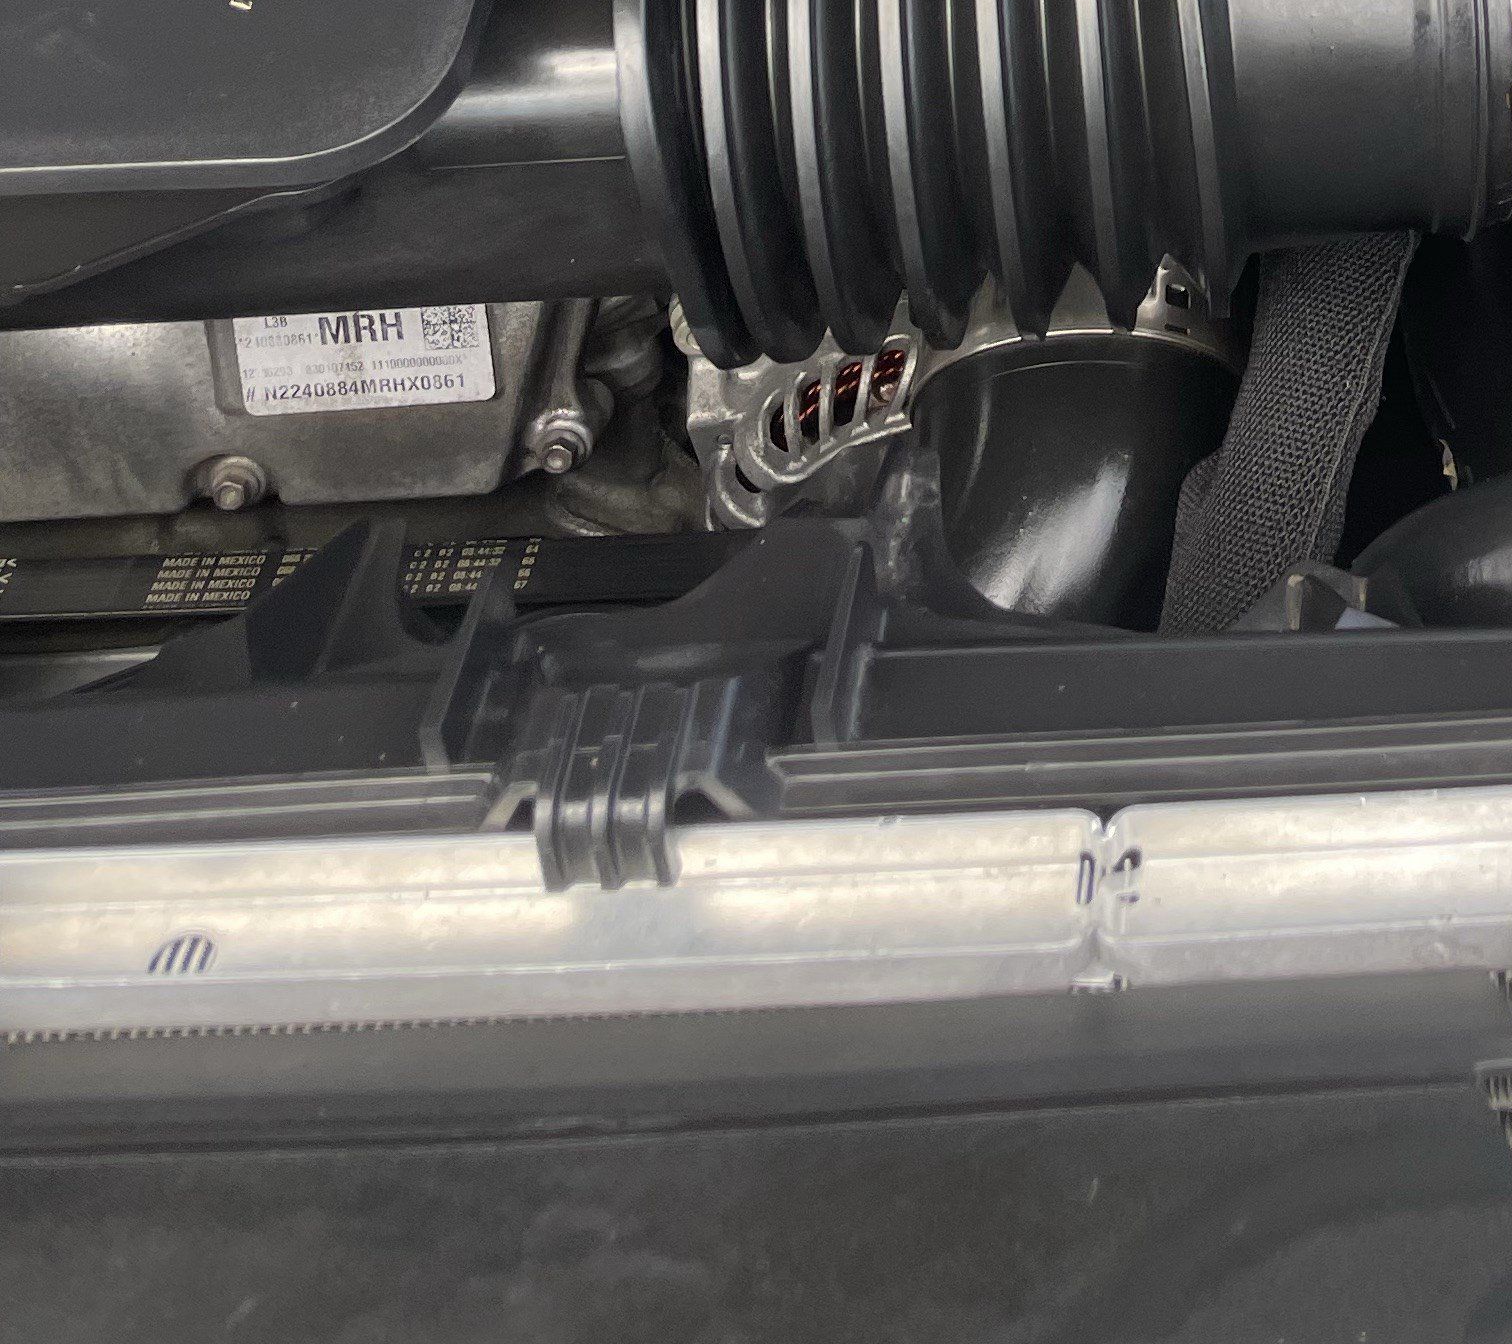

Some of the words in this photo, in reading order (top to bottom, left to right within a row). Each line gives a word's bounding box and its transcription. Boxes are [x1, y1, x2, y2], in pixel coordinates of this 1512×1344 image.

[317, 311, 405, 346] MRH
[162, 557, 200, 567] MADE
[202, 556, 217, 566] IN
[218, 555, 267, 566] MEXICO
[157, 569, 194, 579] MADE
[196, 568, 211, 578] IN
[213, 567, 261, 578] MEXICO
[151, 580, 189, 591] MADE
[190, 580, 206, 590] IN
[207, 578, 256, 589] MEXICO
[145, 592, 183, 603] MADE
[184, 592, 201, 601] IN
[202, 591, 251, 602] MEXICO
